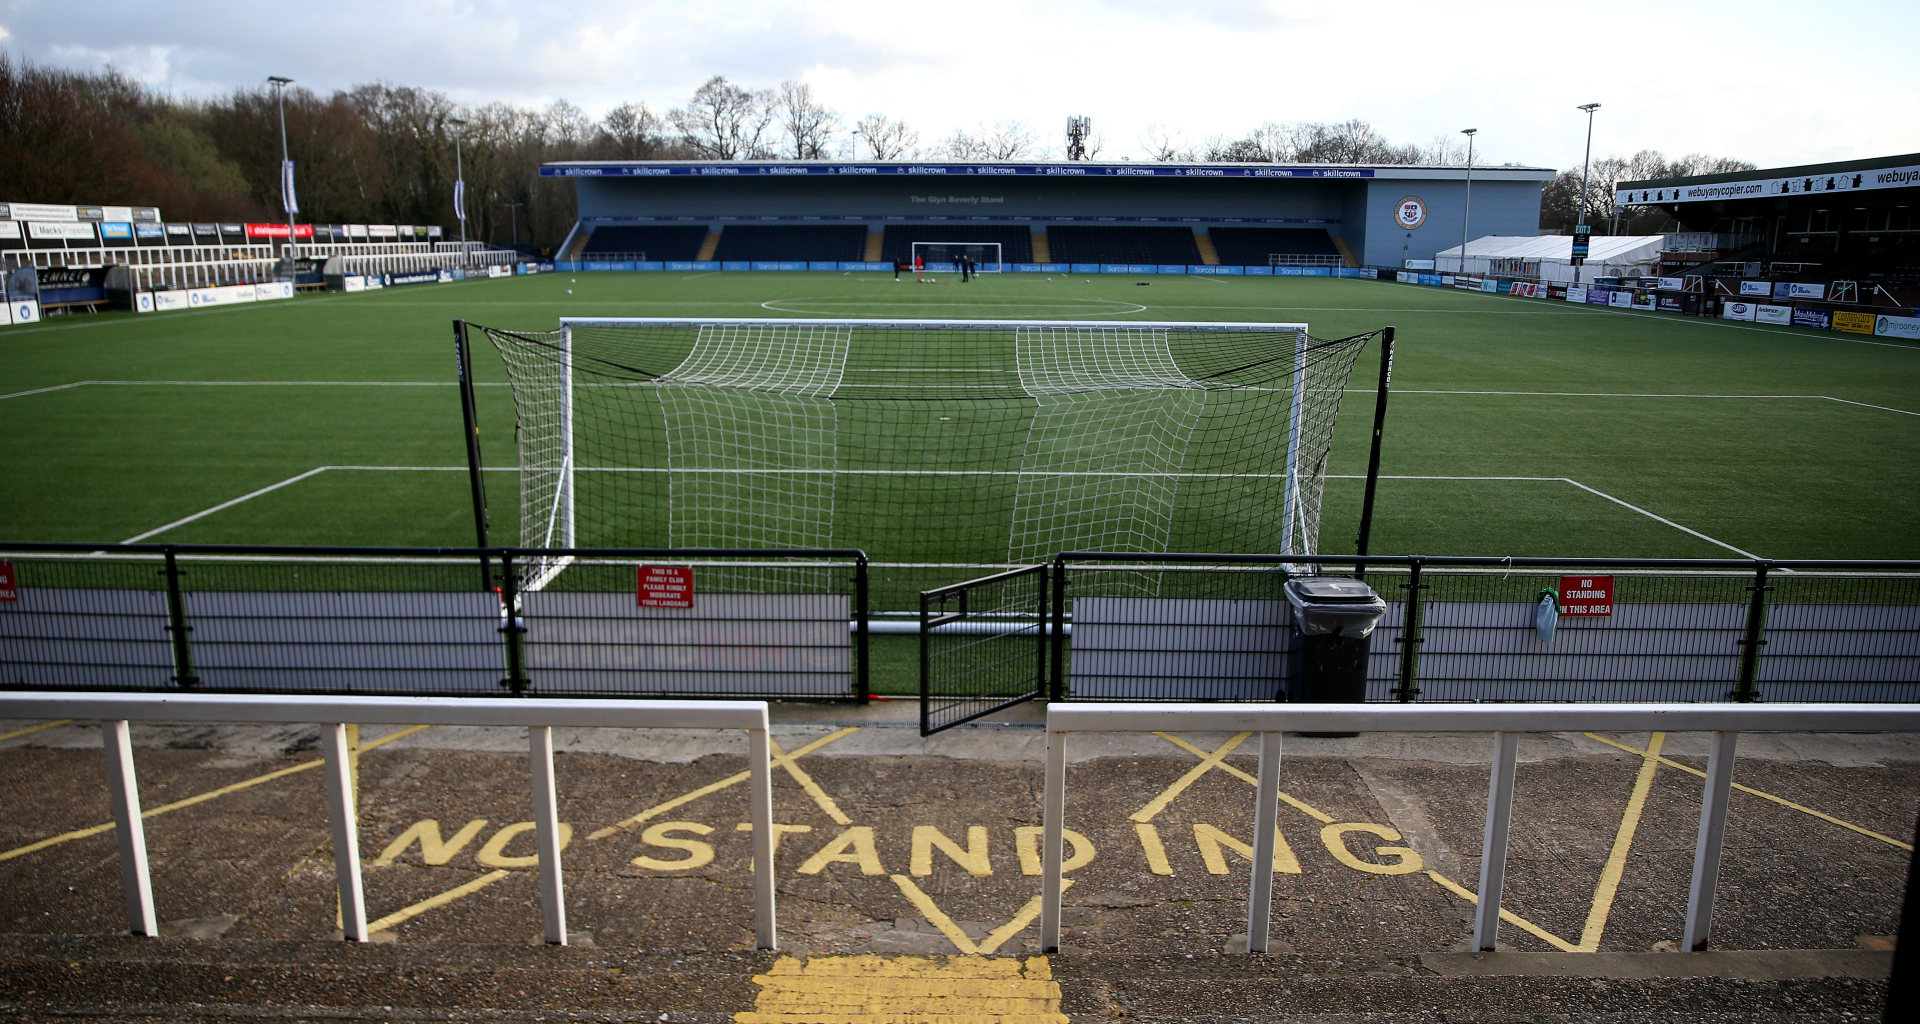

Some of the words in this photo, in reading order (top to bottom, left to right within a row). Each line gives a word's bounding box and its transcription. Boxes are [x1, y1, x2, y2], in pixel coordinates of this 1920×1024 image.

[564, 168, 602, 176] skillcrown
[1878, 170, 1920, 184] webuya
[1688, 184, 1762, 199] webuyanycopier.com
[928, 196, 946, 204] Glyn
[948, 196, 978, 204] Beverly
[0, 590, 16, 598] REA
[1566, 590, 1606, 599] STANDING
[1570, 605, 1587, 613] THIS
[1589, 605, 1610, 613] AREA
[373, 818, 573, 868] NO
[631, 820, 1424, 876] STANDING
